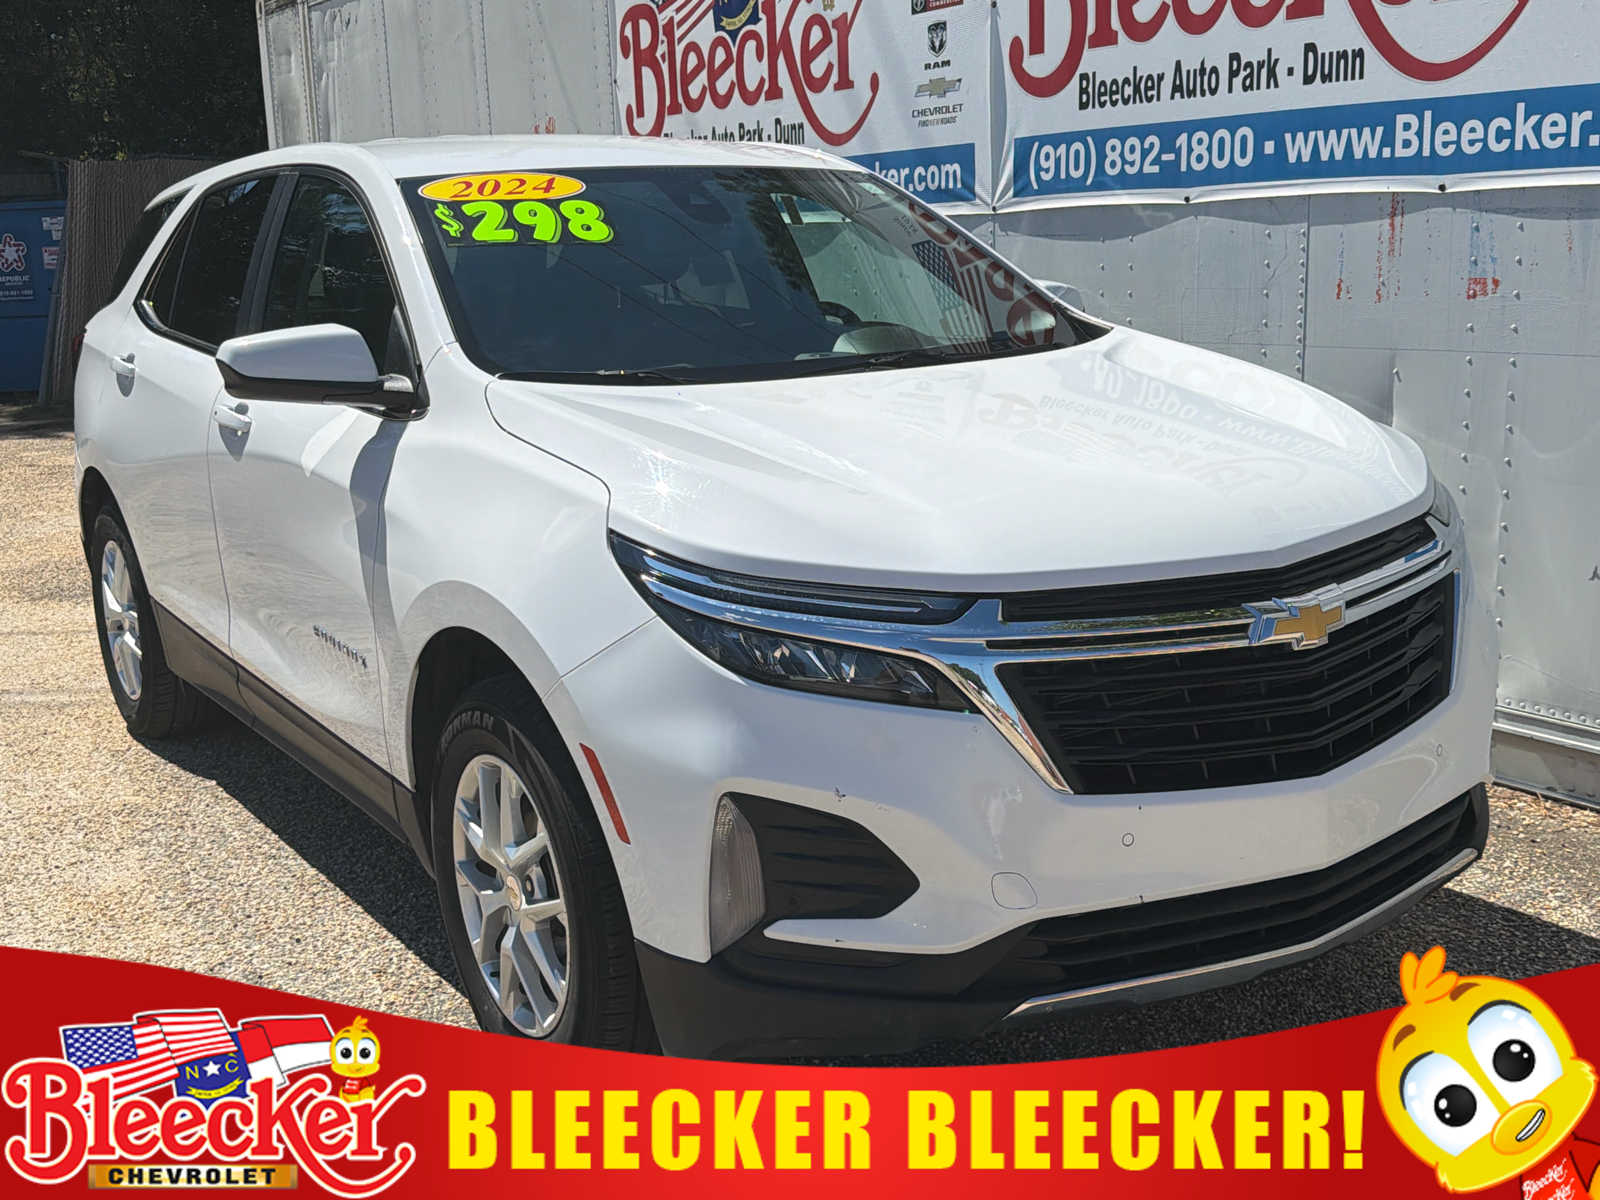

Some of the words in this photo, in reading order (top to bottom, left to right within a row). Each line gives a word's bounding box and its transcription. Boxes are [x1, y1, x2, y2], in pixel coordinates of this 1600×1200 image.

[620, 0, 879, 146] Bleecker
[924, 59, 952, 71] RAM
[1078, 66, 1164, 110] Bleecker
[1170, 57, 1220, 101] Auto
[1227, 48, 1280, 94] Park
[1302, 42, 1365, 85] Dunn
[911, 103, 964, 119] CHEVROLET
[1029, 136, 1097, 190] (910)
[1104, 126, 1255, 177] 892-1800
[450, 176, 556, 199] 2024
[434, 200, 614, 243] $298
